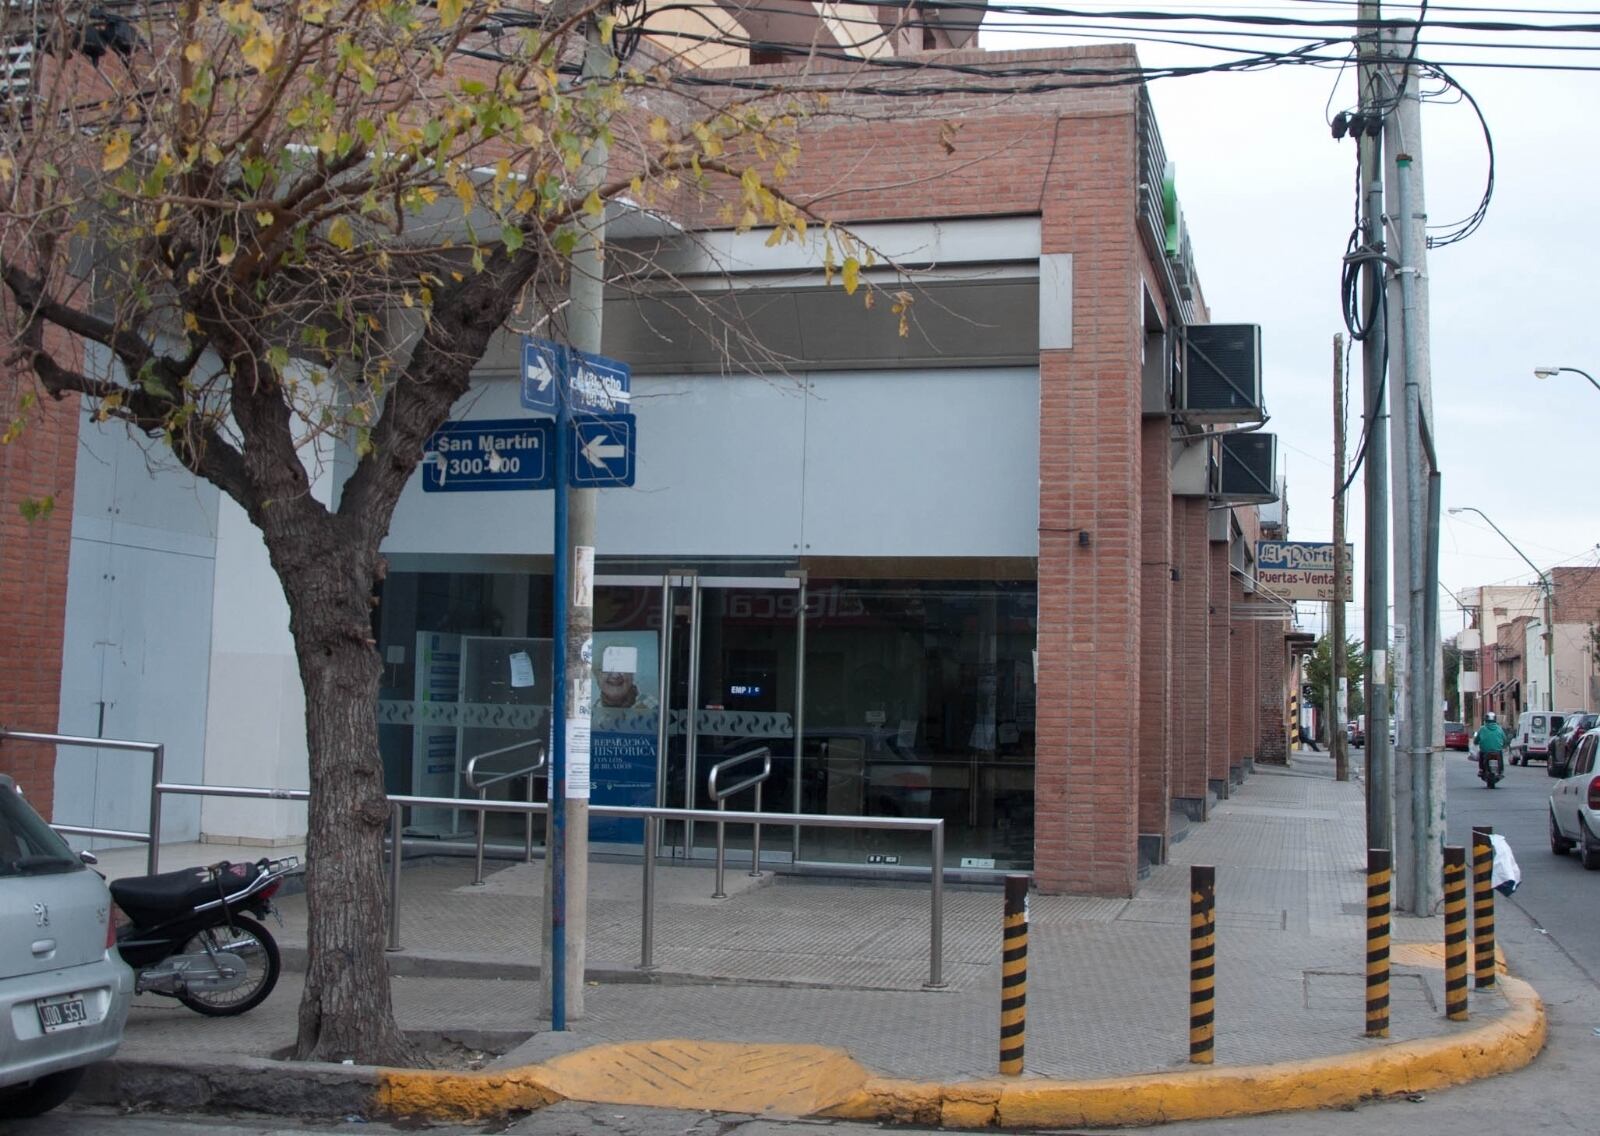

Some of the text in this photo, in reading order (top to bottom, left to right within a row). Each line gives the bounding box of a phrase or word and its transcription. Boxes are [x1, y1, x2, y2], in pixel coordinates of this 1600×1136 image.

[438, 432, 539, 452] San Martín
[1262, 546, 1280, 561] El
[63, 1001, 83, 1021] 557
